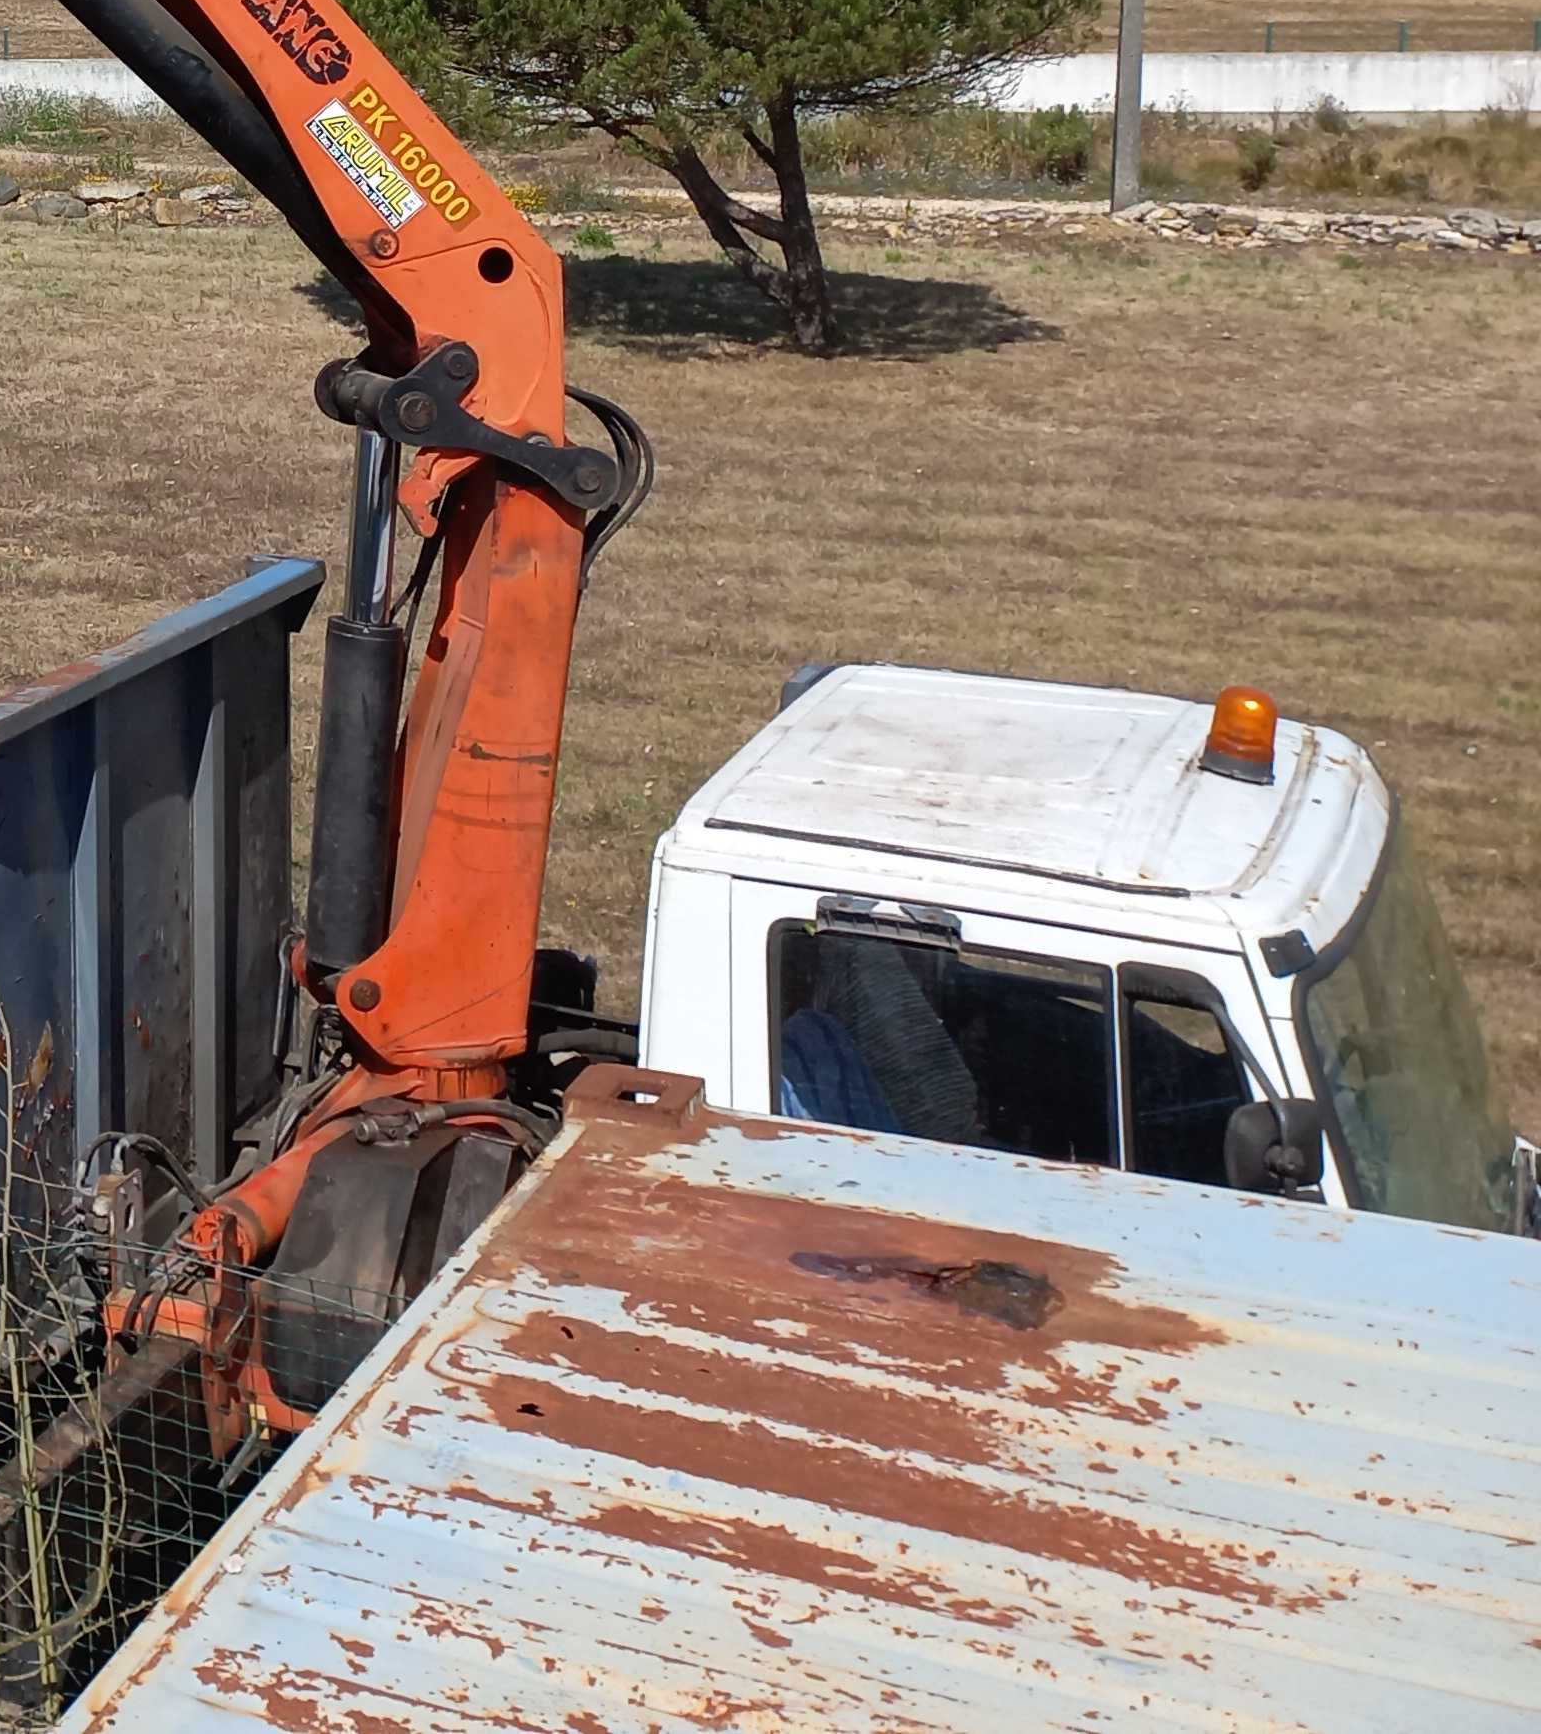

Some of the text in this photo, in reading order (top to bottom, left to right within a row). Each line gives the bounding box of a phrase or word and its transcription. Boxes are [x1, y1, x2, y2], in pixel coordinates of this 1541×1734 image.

[318, 115, 404, 218] GRUMIL
[348, 86, 398, 139] PK
[390, 131, 472, 224] 16000
